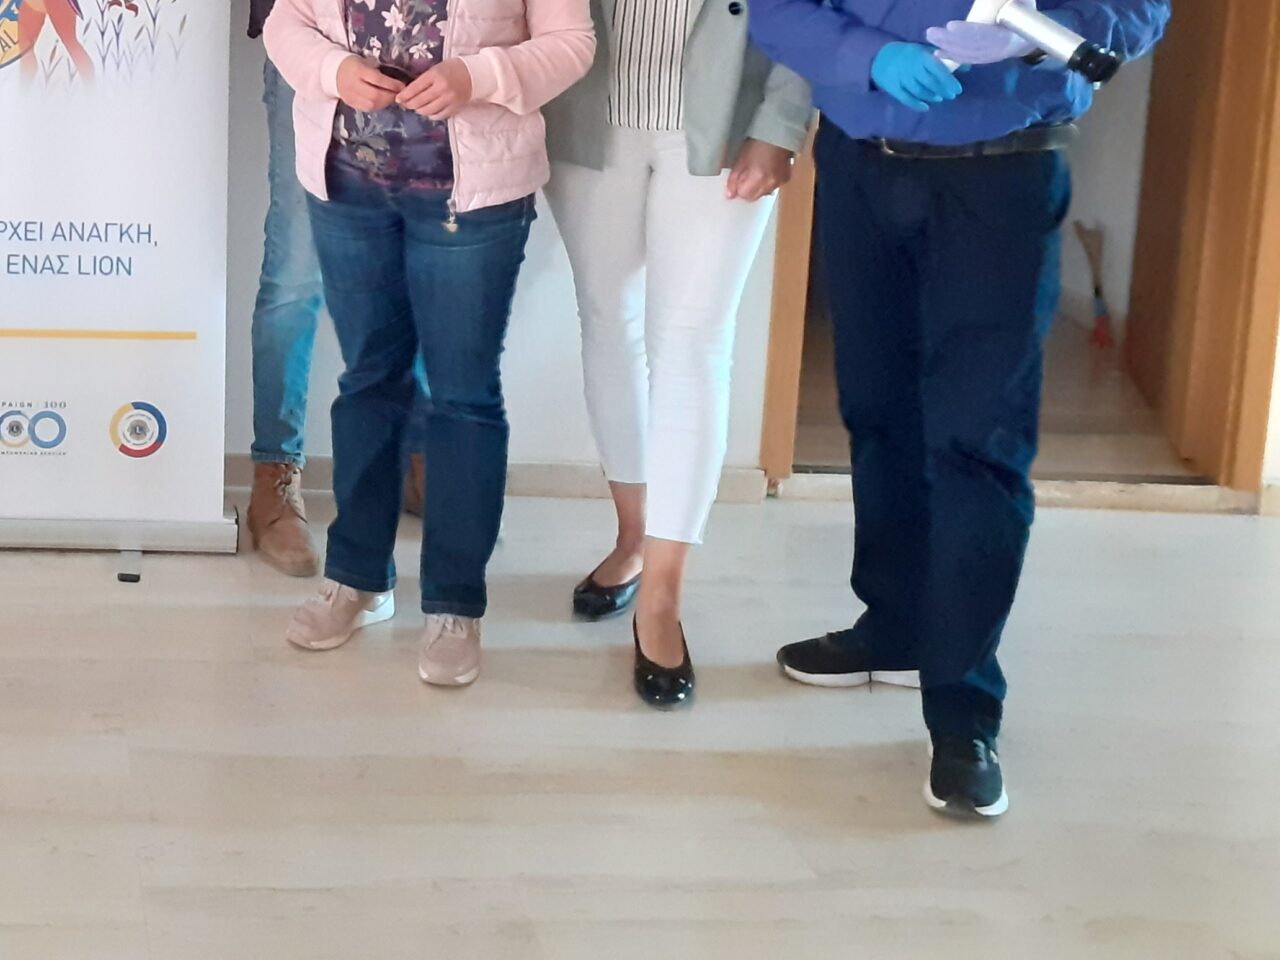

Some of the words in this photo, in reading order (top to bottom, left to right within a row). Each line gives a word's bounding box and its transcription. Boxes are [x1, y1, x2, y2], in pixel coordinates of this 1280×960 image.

[51, 222, 158, 247] ΑΝΑΓΚΗ,
[6, 254, 69, 275] ΕΝΑΣ
[77, 255, 133, 276] LION
[44, 401, 67, 409] 100
